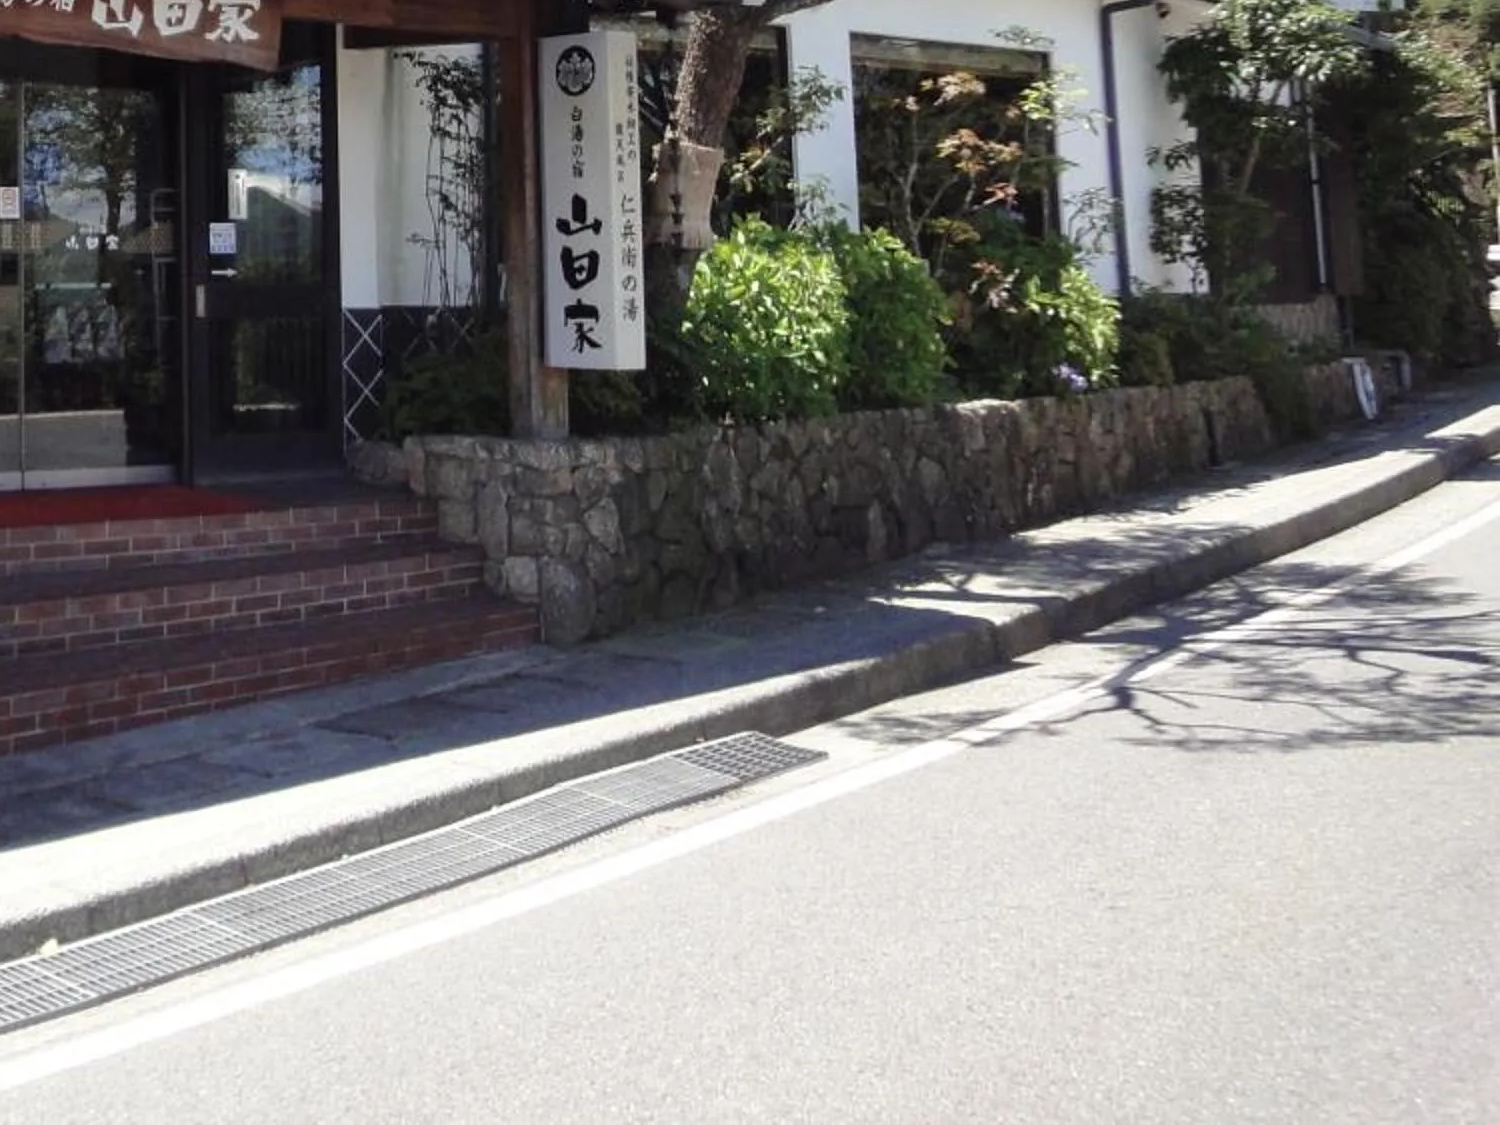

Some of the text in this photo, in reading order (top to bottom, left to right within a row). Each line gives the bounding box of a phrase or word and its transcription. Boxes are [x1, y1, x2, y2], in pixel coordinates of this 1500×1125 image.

[555, 106, 603, 354] 白湯の宿 山田家
